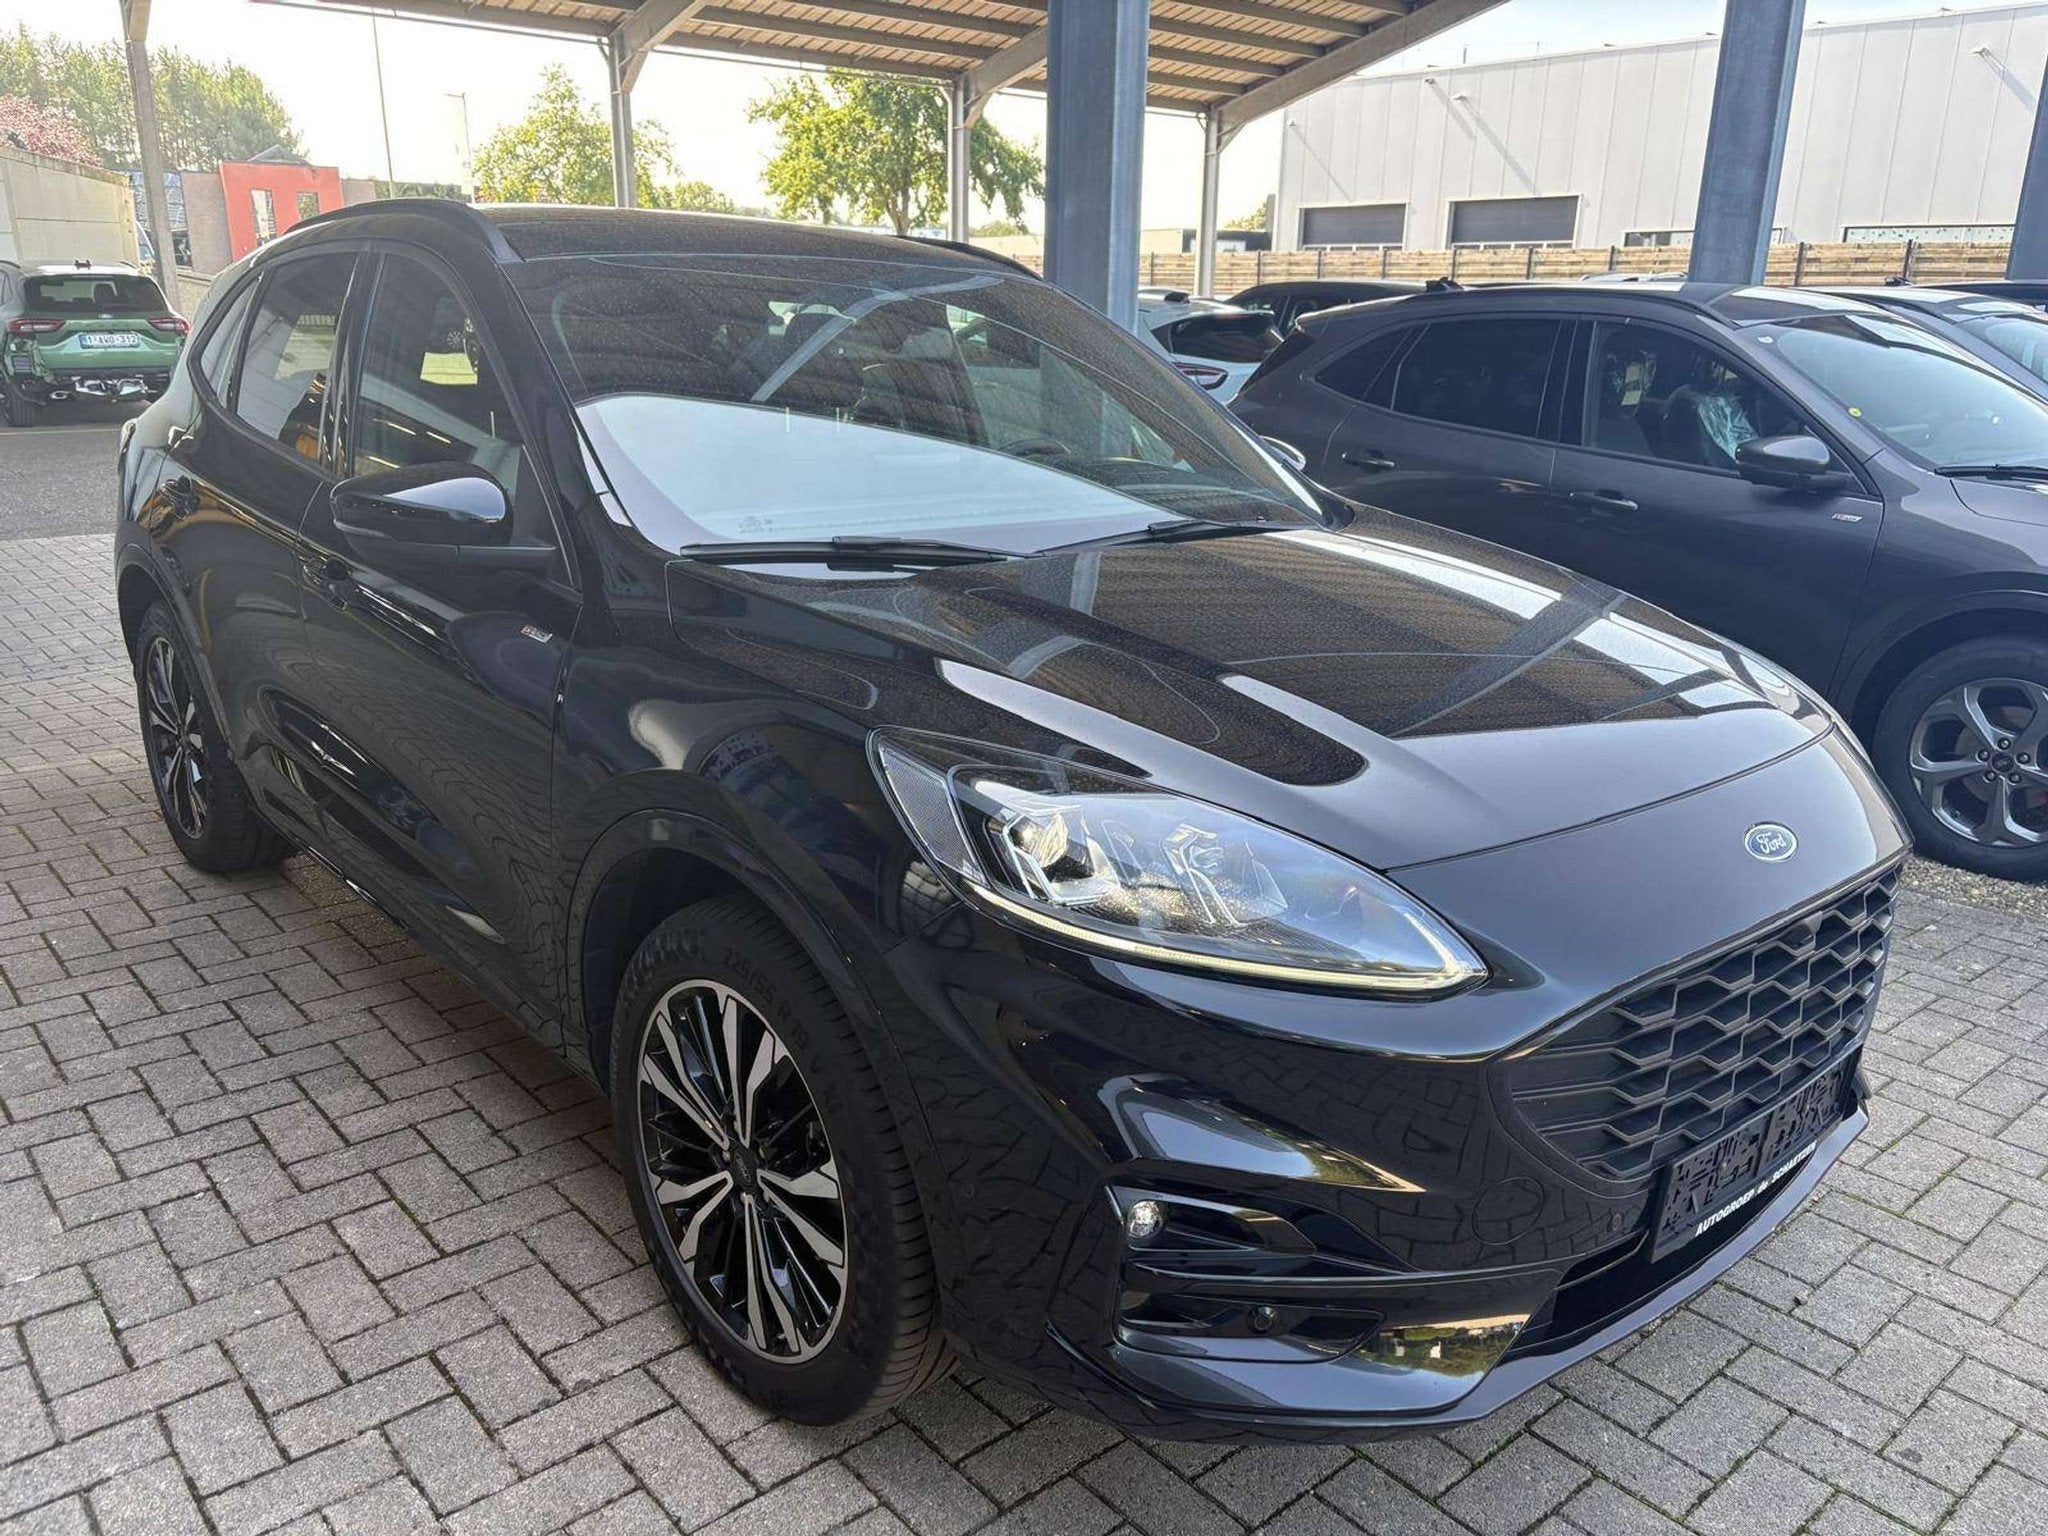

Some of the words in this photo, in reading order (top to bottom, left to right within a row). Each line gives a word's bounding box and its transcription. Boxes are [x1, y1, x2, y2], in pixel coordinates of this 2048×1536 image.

[1756, 831, 1787, 854] Ford
[1695, 1188, 1756, 1237] AUTOGROEP
[1757, 1180, 1770, 1195] de
